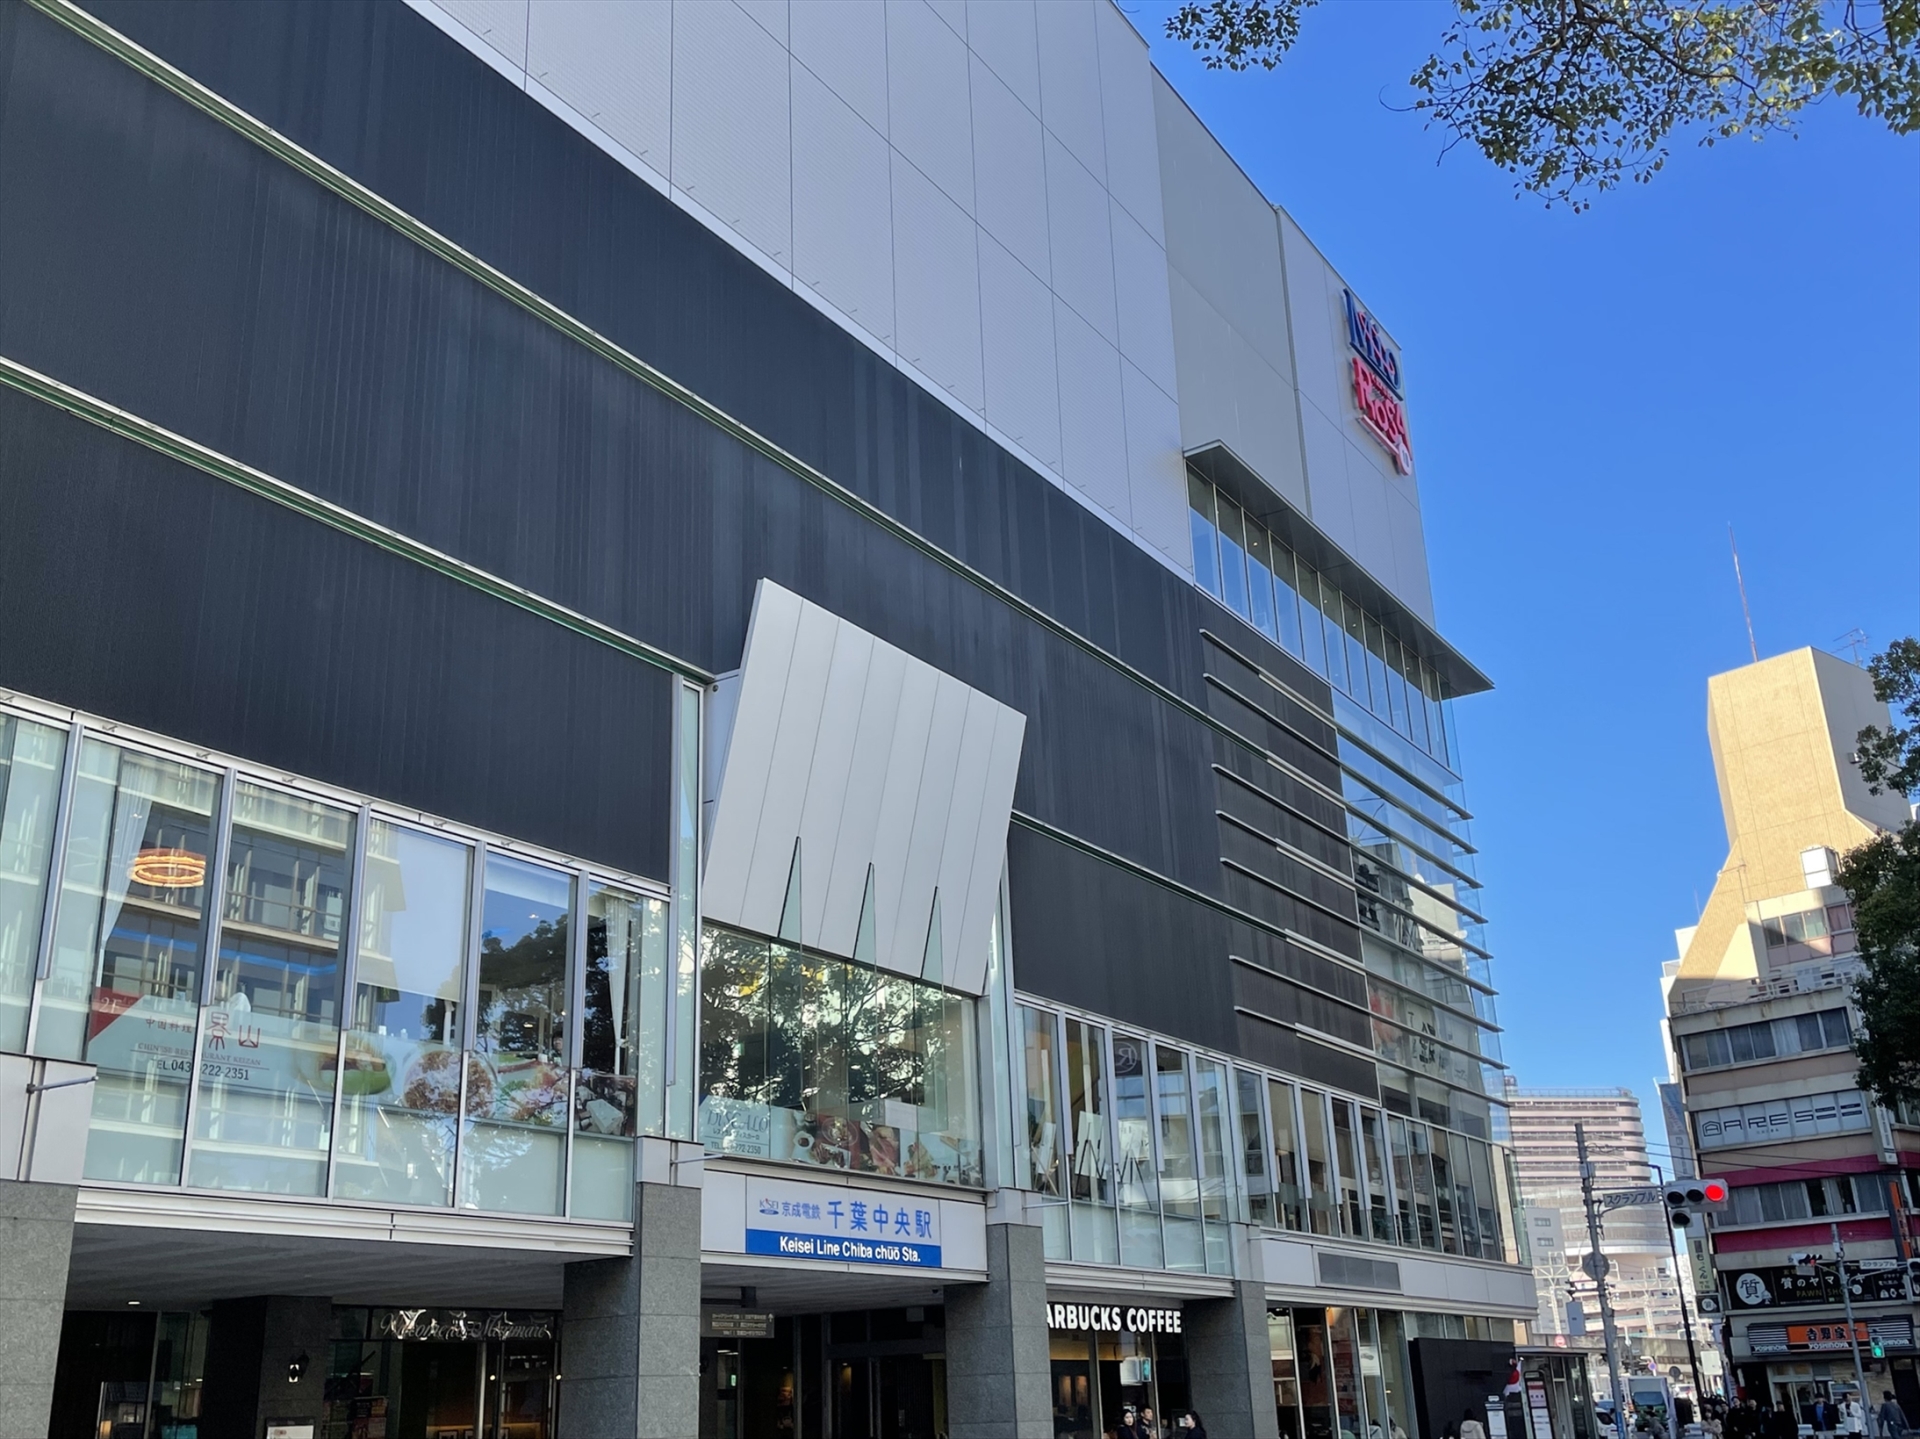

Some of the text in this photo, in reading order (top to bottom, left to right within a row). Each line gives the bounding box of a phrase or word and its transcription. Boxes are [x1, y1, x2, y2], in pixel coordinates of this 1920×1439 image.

[98, 996, 122, 1014] 2F
[145, 1015, 193, 1034] 中国料理
[174, 1047, 231, 1061] RESTURANT
[152, 1058, 250, 1081] TEL.043222-2351
[1606, 1191, 1656, 1205] スクランブル
[781, 1200, 932, 1239] 京成電鉄 千葉中央駅
[779, 1236, 921, 1263] Keisei Line Chiba chūō Sta.
[1739, 1279, 1761, 1299] 質
[1796, 1287, 1844, 1298] PAWN SHO
[1047, 1303, 1182, 1334] ARBUCKS COFFEE
